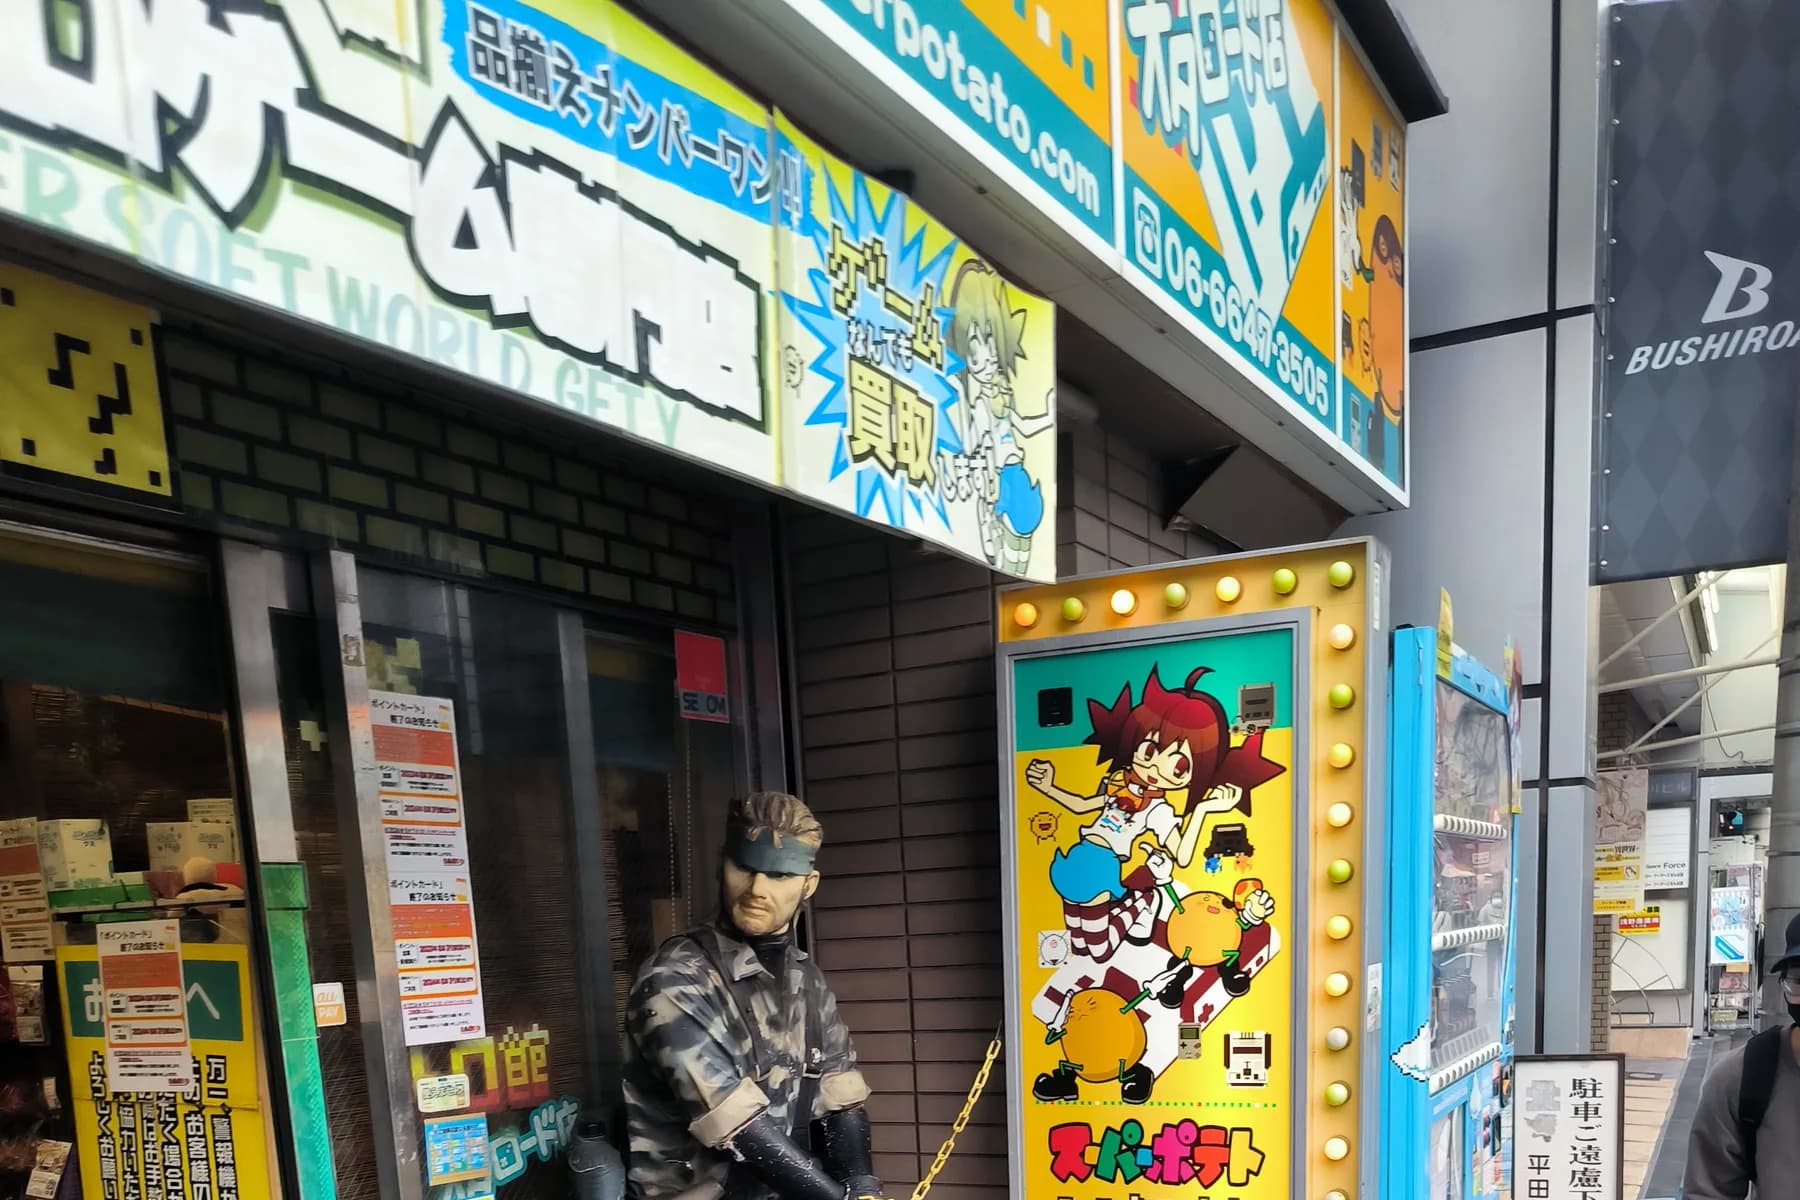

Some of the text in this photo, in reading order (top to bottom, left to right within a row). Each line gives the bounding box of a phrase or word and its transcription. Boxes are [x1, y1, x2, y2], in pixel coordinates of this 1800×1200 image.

[102, 182, 312, 317] SOFT
[1702, 249, 1773, 325] B
[827, 222, 946, 373] ゲーム
[847, 317, 916, 373] なんでも
[848, 354, 937, 496] 買取
[682, 691, 726, 714] SEOM
[1048, 1118, 1265, 1189] スーパーポテト
